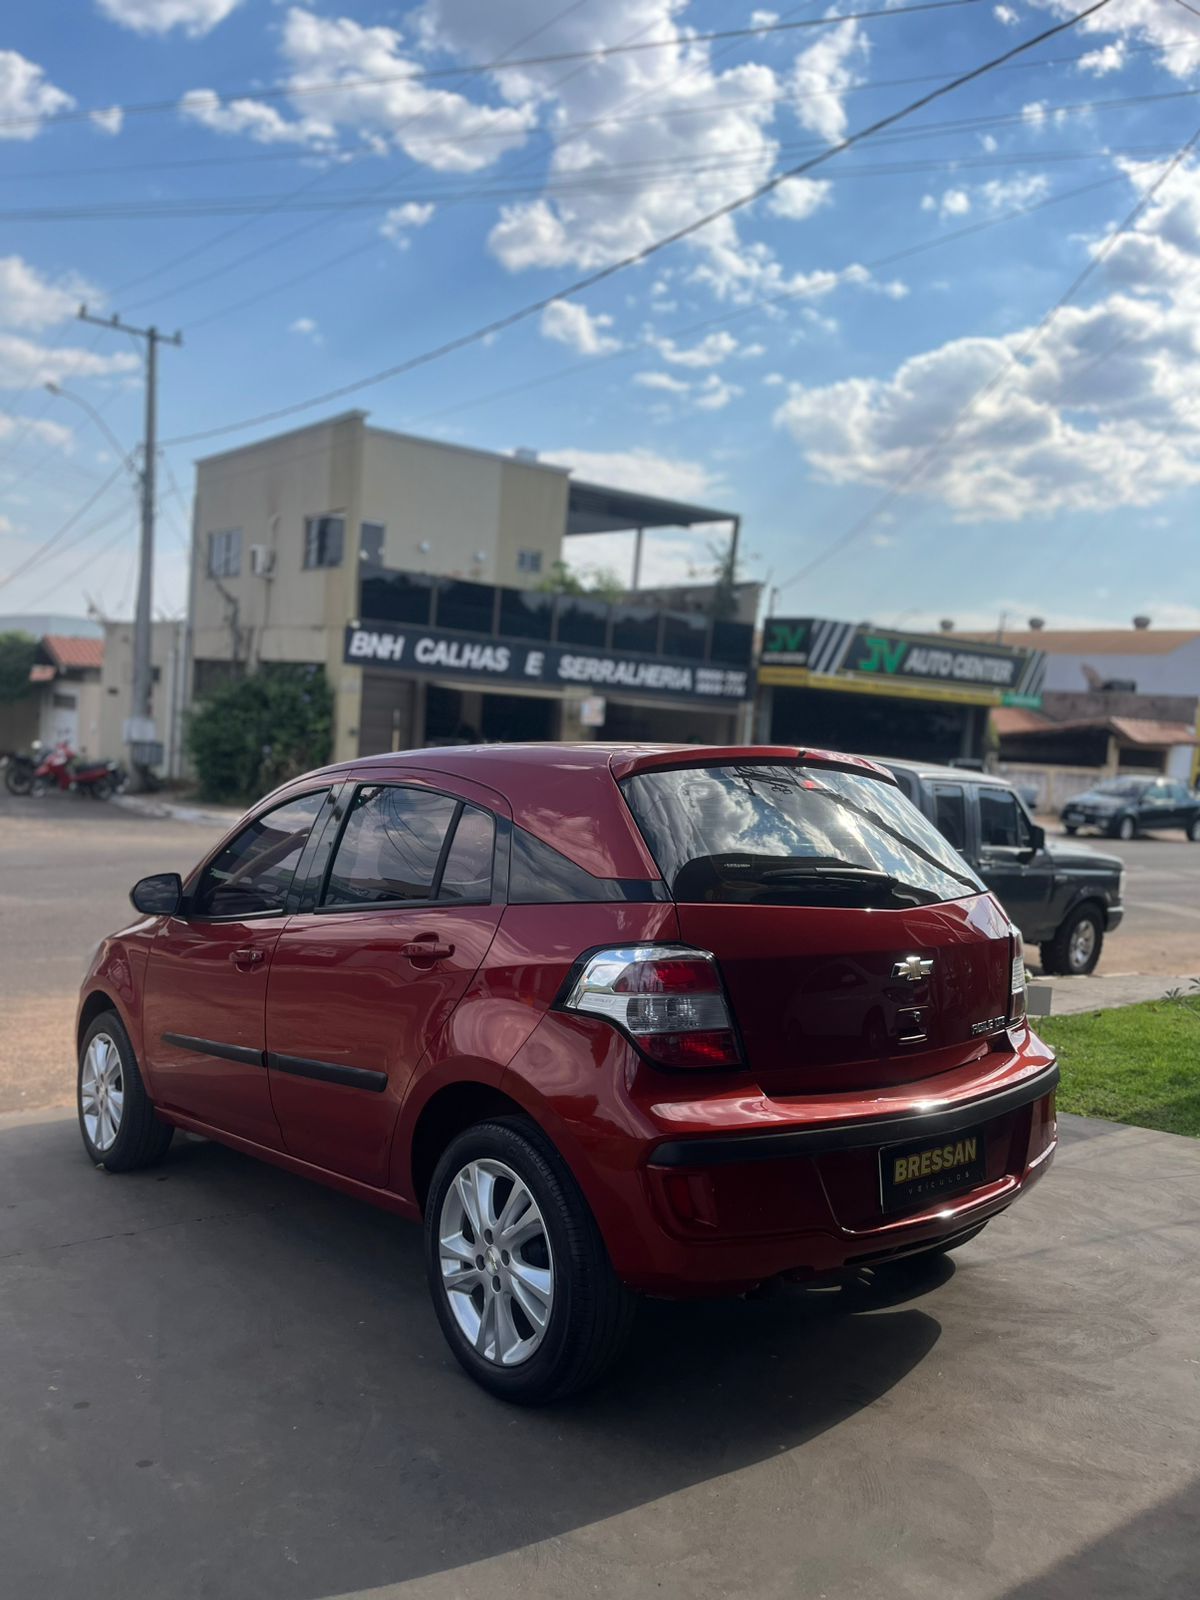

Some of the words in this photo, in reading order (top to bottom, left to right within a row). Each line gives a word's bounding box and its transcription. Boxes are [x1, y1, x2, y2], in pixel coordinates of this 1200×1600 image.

[349, 631, 405, 661] BNH
[415, 638, 511, 672] CALHAS
[525, 651, 545, 676] E
[557, 654, 692, 691] SERRALHERIA
[859, 636, 907, 673] JV
[904, 648, 949, 677] AUTO
[950, 655, 1013, 684] CENTER
[894, 1137, 977, 1184] BRESSAN
